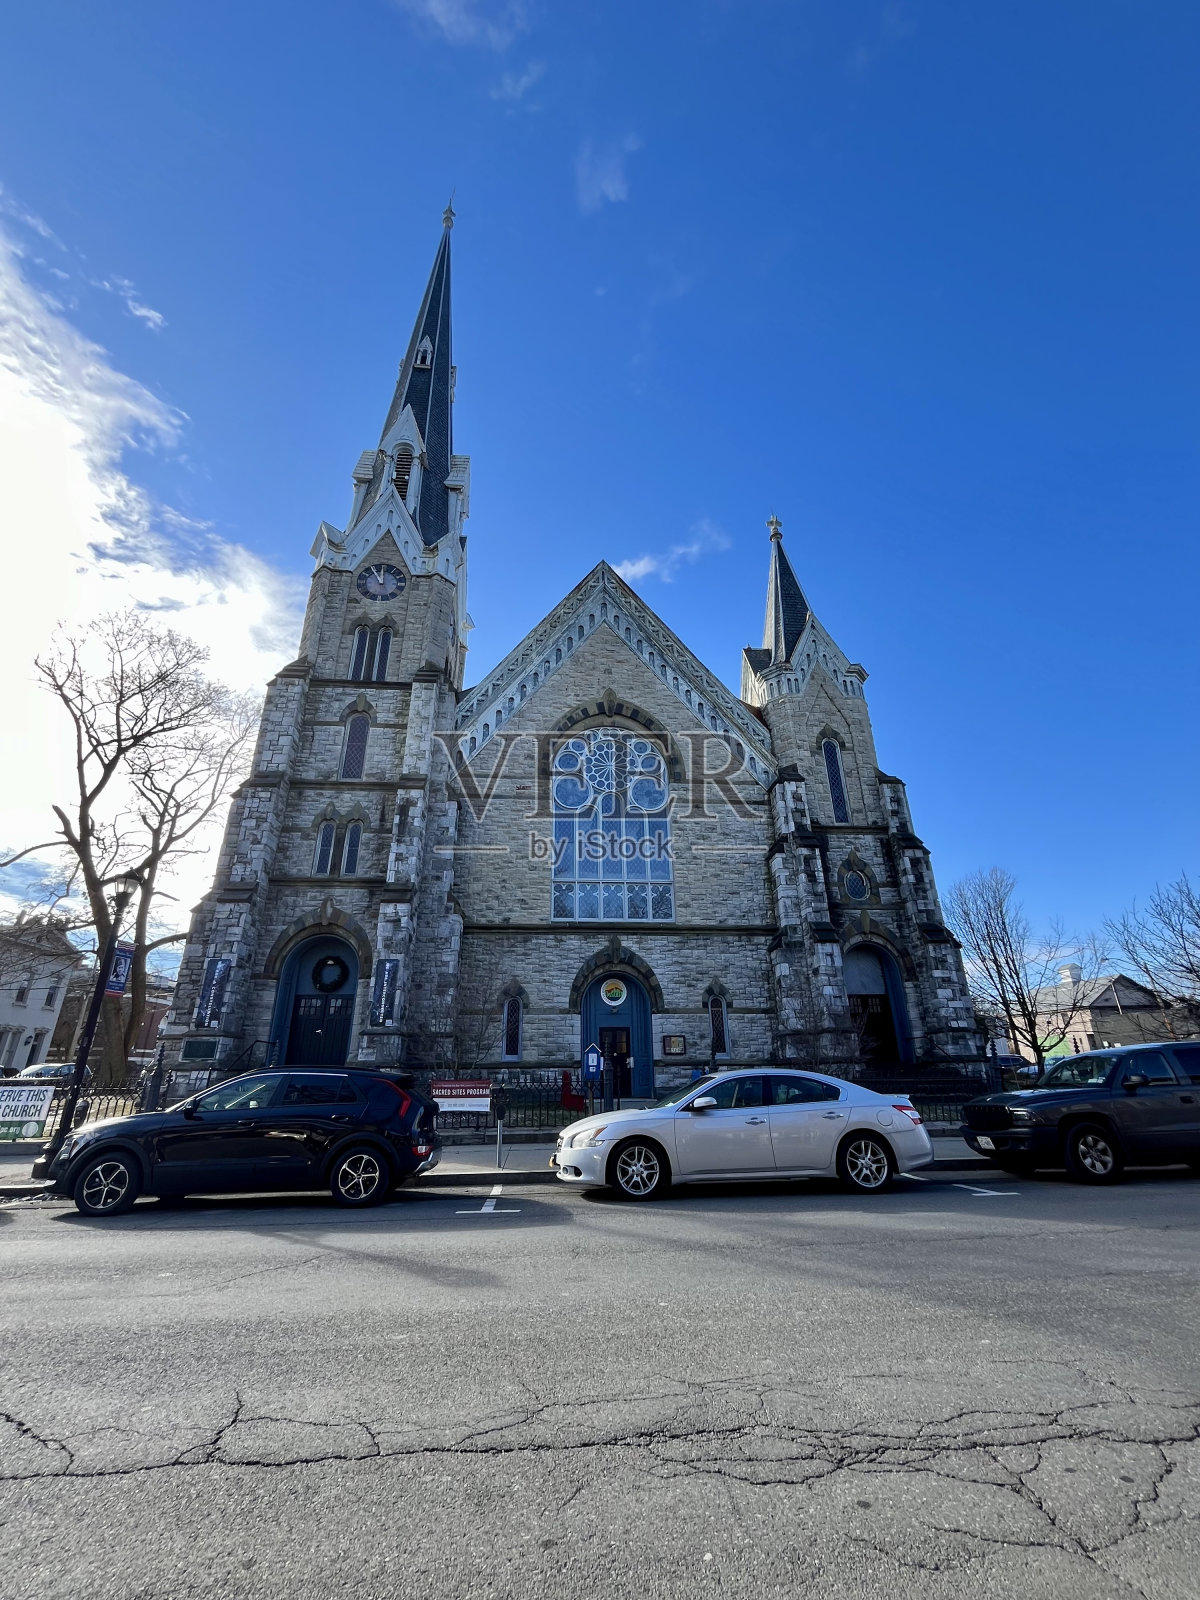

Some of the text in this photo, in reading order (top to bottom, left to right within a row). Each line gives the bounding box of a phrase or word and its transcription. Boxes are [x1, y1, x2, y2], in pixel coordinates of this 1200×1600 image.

[0, 1089, 48, 1101] ERVE THIS
[432, 1088, 490, 1096] SACRED SITES PROGRAM
[2, 1104, 43, 1117] CHURCH
